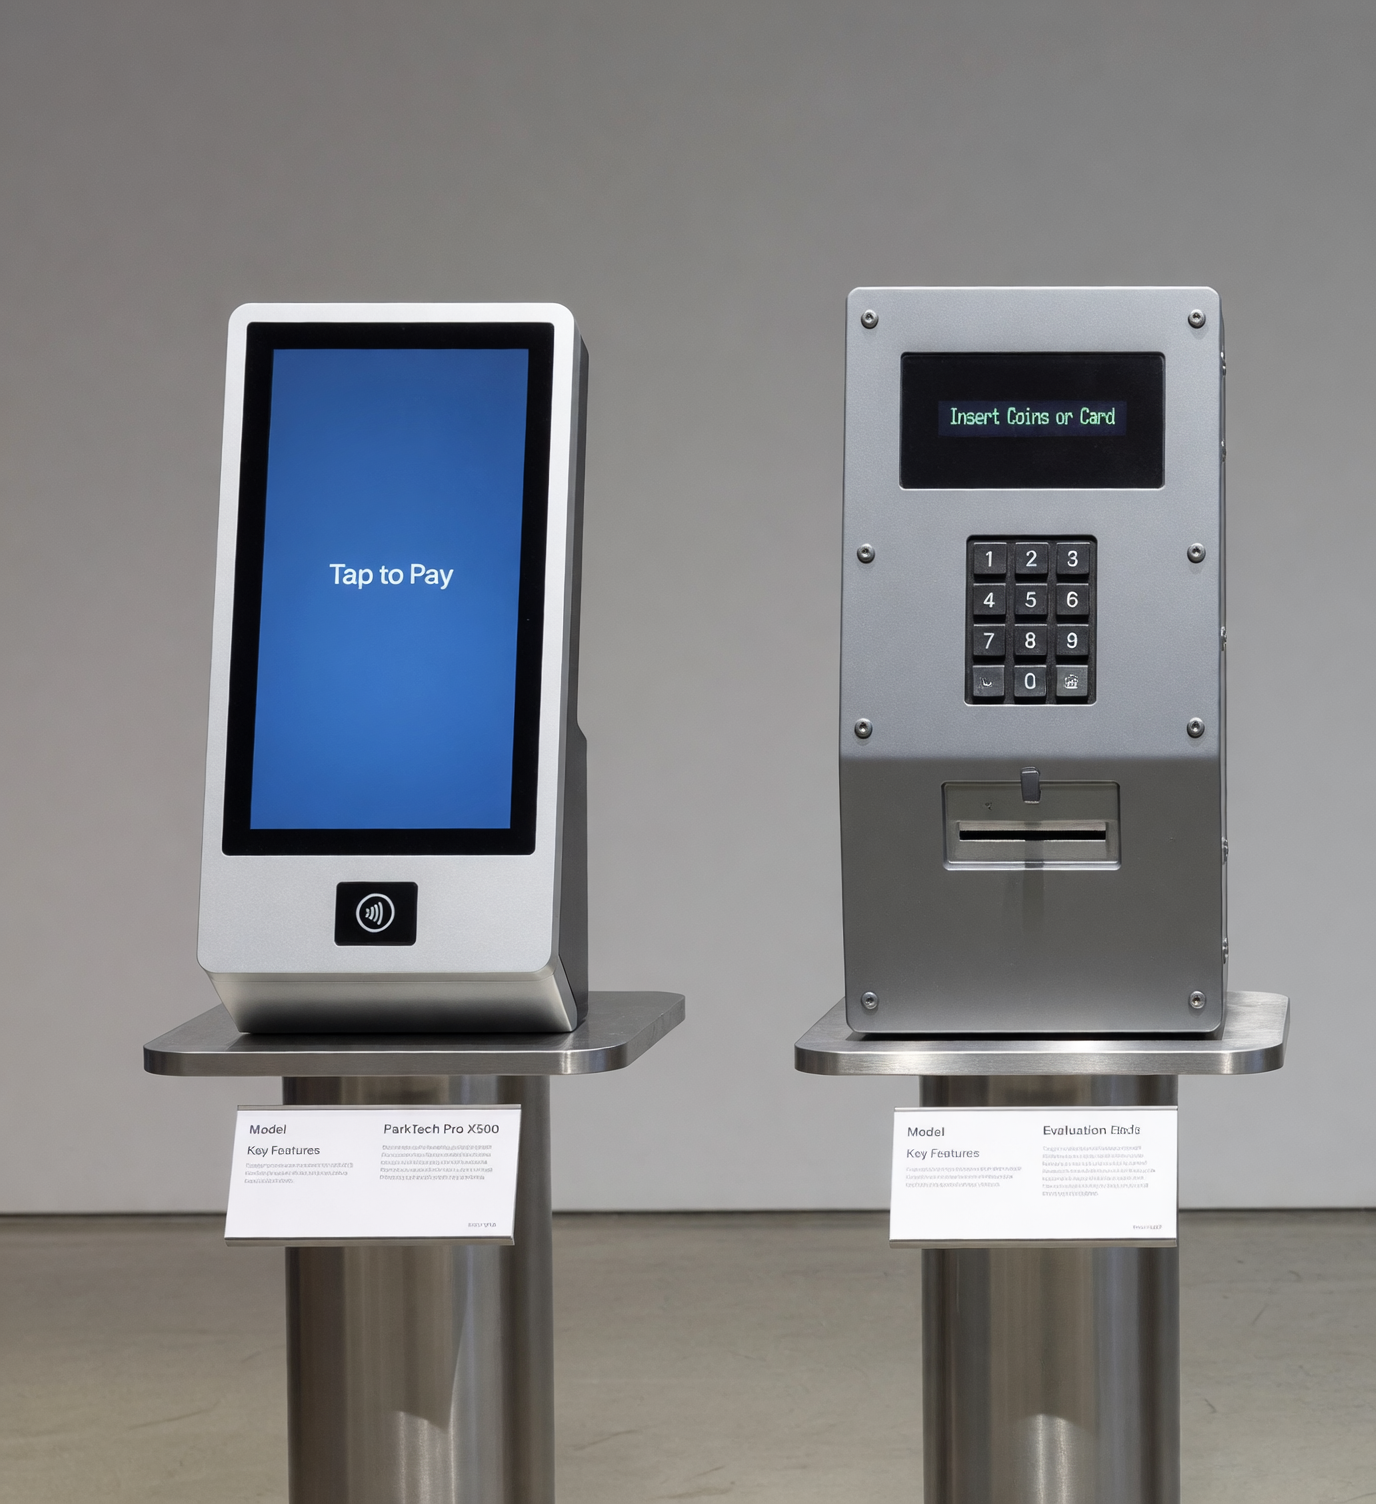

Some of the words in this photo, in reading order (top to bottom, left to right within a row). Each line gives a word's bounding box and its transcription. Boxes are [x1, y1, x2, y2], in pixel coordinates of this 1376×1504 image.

[950, 407, 1000, 426] Insert
[1007, 406, 1050, 426] Coins
[1055, 411, 1074, 426] or
[1079, 406, 1116, 425] Card
[985, 550, 993, 568] 1
[1025, 549, 1038, 567] 2
[1067, 550, 1079, 568] 3
[329, 563, 374, 590] Tap
[378, 565, 404, 585] to
[410, 563, 455, 590] Pay
[983, 592, 996, 608] 4
[1024, 591, 1037, 608] 5
[1066, 591, 1079, 608] 6
[983, 632, 995, 650] 7
[1024, 631, 1036, 649] 8
[1066, 632, 1078, 649] 9
[1024, 672, 1037, 690] 0
[249, 1124, 287, 1135] Model
[383, 1123, 440, 1135] ParkTech
[443, 1123, 464, 1134] Pro
[467, 1123, 500, 1134] X500
[907, 1126, 945, 1137] Model
[1043, 1124, 1107, 1136] Evaluation
[247, 1145, 269, 1158] Key
[271, 1145, 321, 1156] Features
[906, 1148, 928, 1161] Key
[930, 1148, 980, 1159] Features
